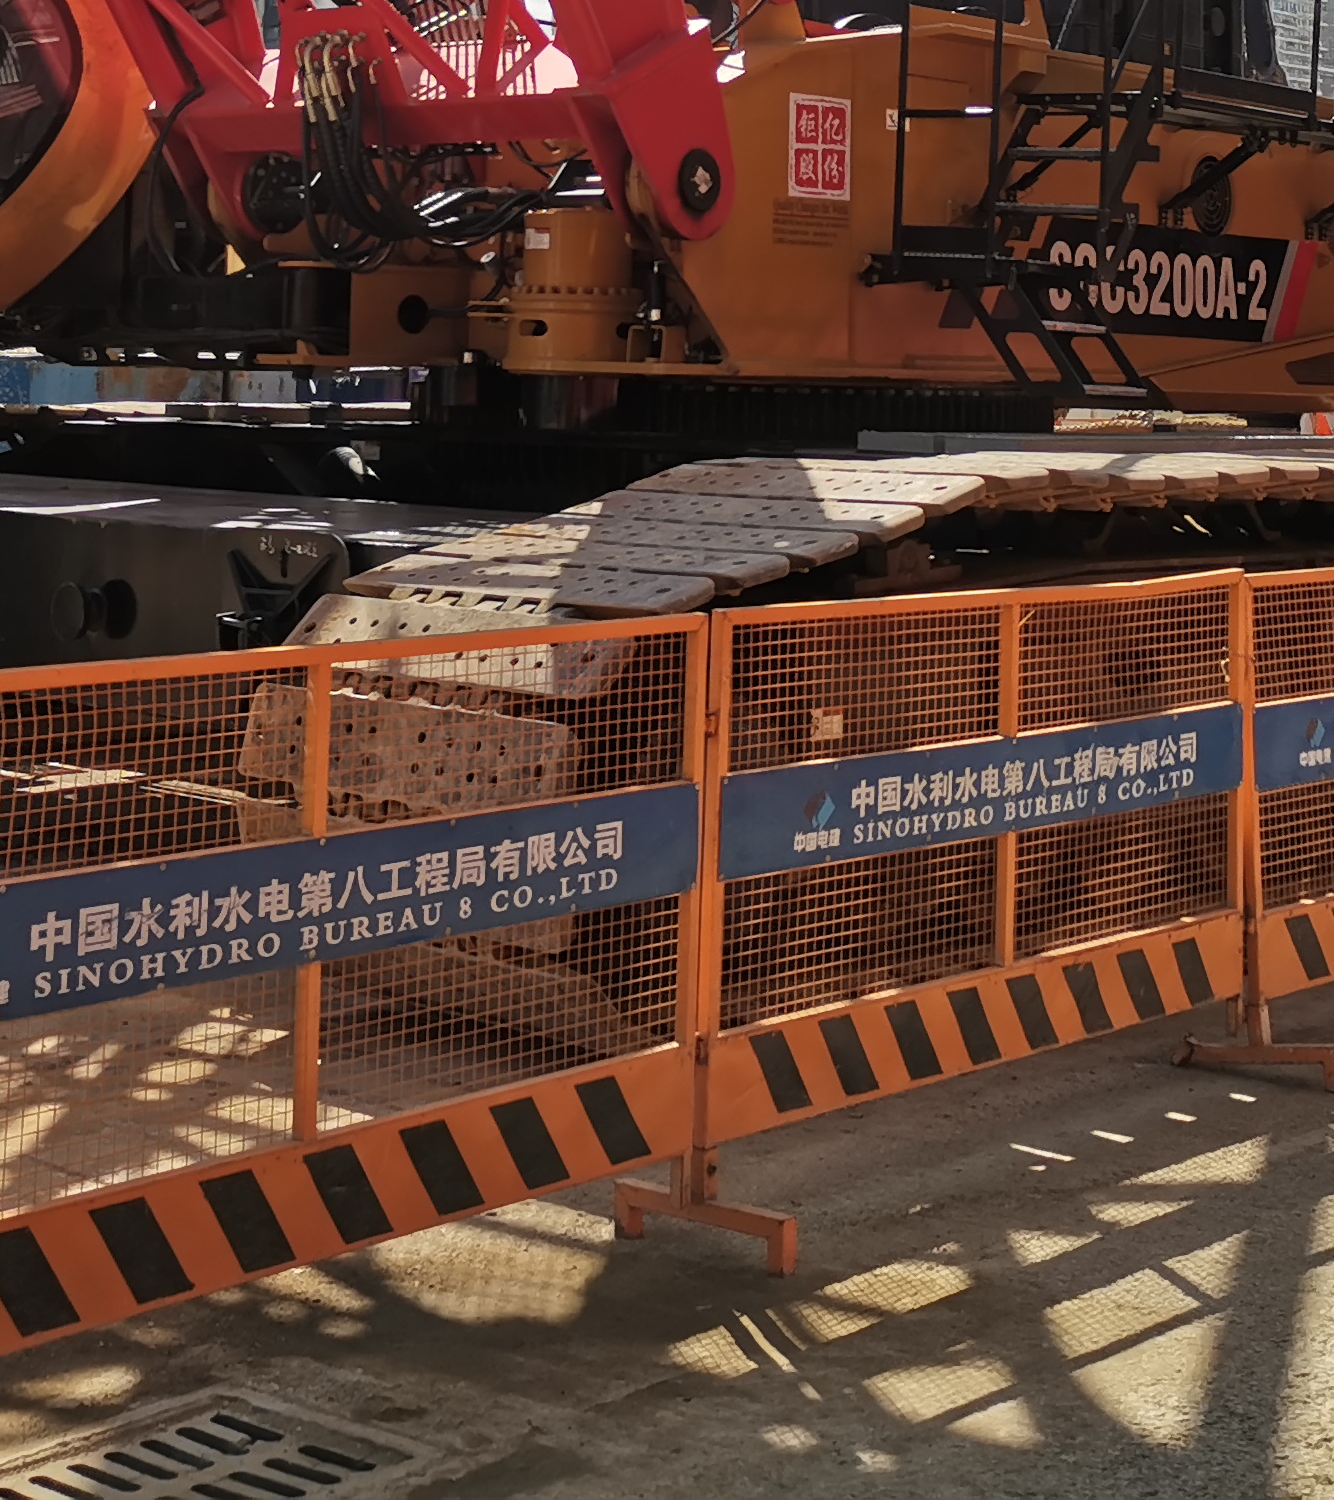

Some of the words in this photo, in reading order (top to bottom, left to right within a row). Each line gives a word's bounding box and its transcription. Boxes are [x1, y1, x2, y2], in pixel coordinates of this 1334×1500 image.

[799, 152, 843, 184] 股份
[851, 731, 1197, 819] 中国水利水电第八工程局有限公司
[853, 805, 994, 844] SINOHYDRO
[1004, 787, 1089, 821] BUREAU
[1097, 785, 1107, 804] 8
[1117, 768, 1194, 801] CO.,LTD
[793, 827, 841, 853] 中国电建
[29, 820, 624, 963] 中国水利水电第八工程局有限公司
[34, 931, 281, 999] SINOHYDRO
[299, 902, 444, 951] BUREAU
[459, 897, 472, 920] 8
[490, 868, 619, 913] CO.,LTD
